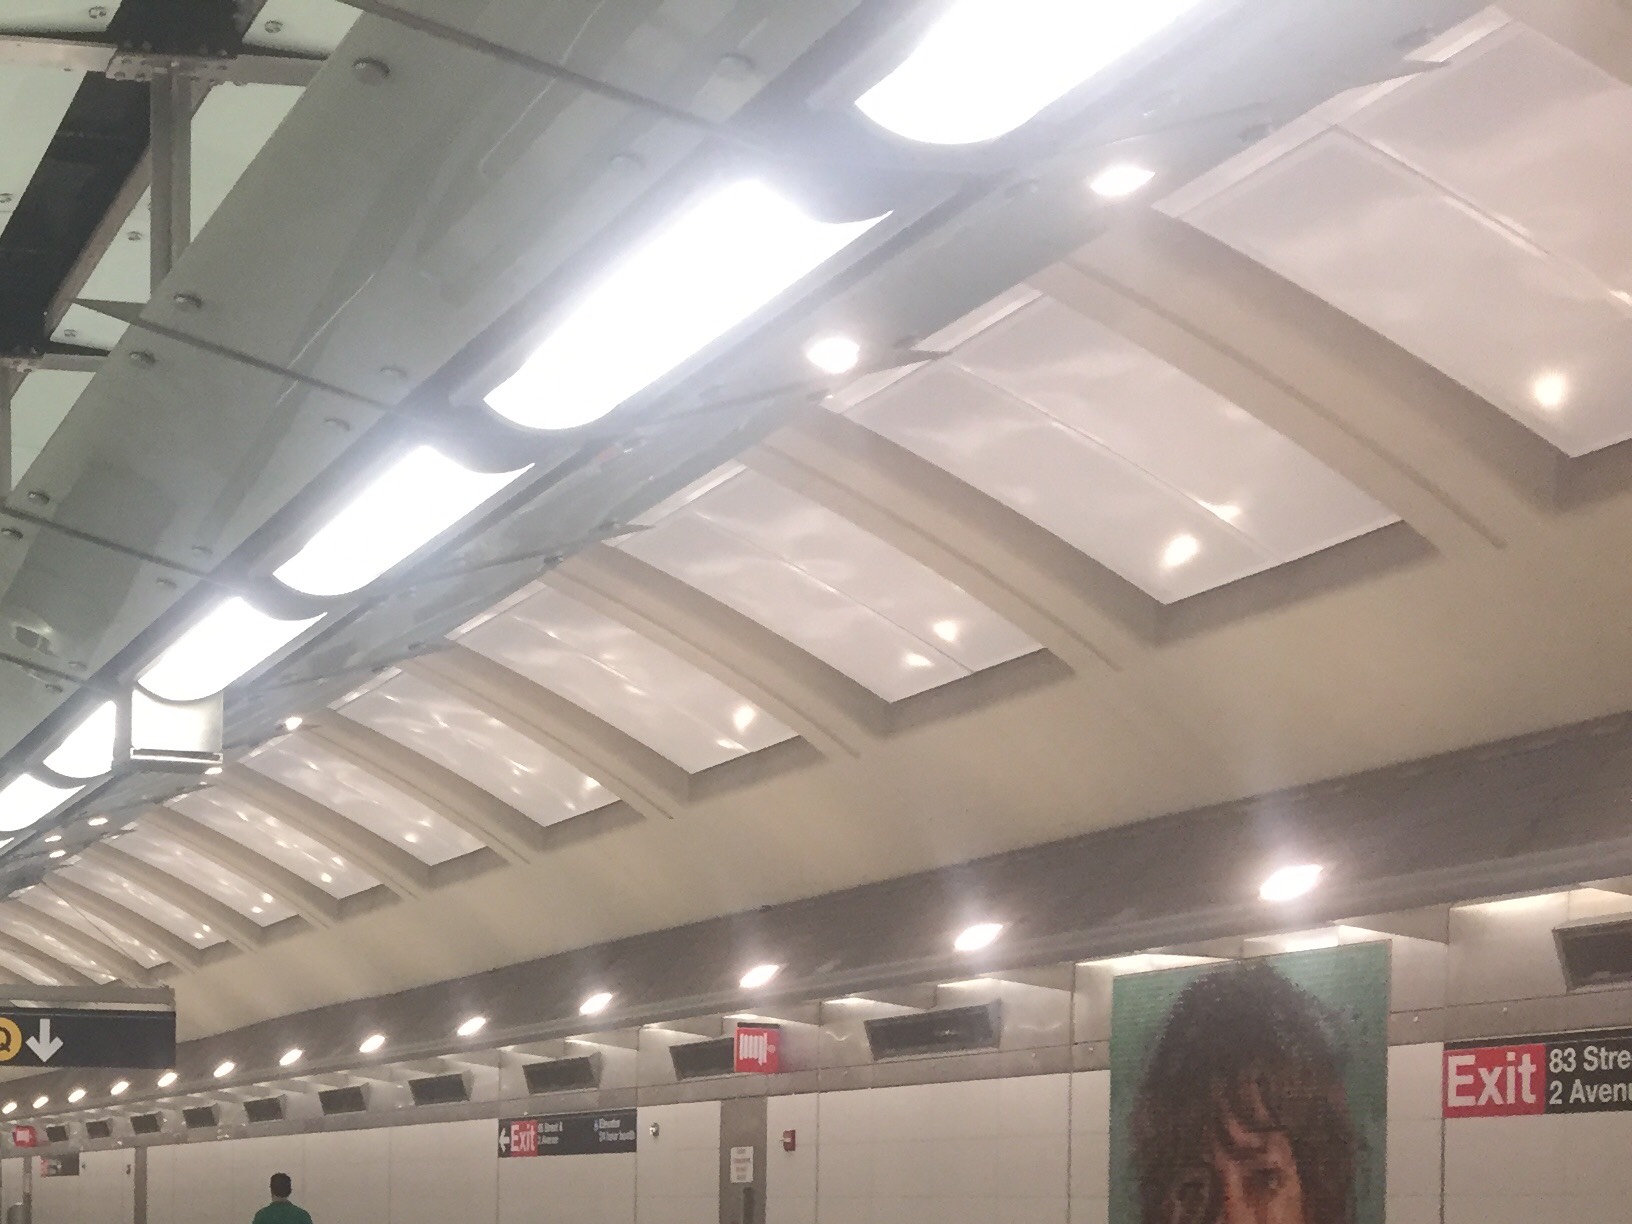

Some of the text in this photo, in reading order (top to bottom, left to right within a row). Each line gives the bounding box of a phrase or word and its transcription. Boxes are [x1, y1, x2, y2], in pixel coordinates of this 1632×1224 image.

[1549, 1045, 1632, 1073] 83 Stre
[1447, 1051, 1537, 1107] Exit
[1549, 1080, 1563, 1105] 2
[510, 1123, 536, 1152] Exit
